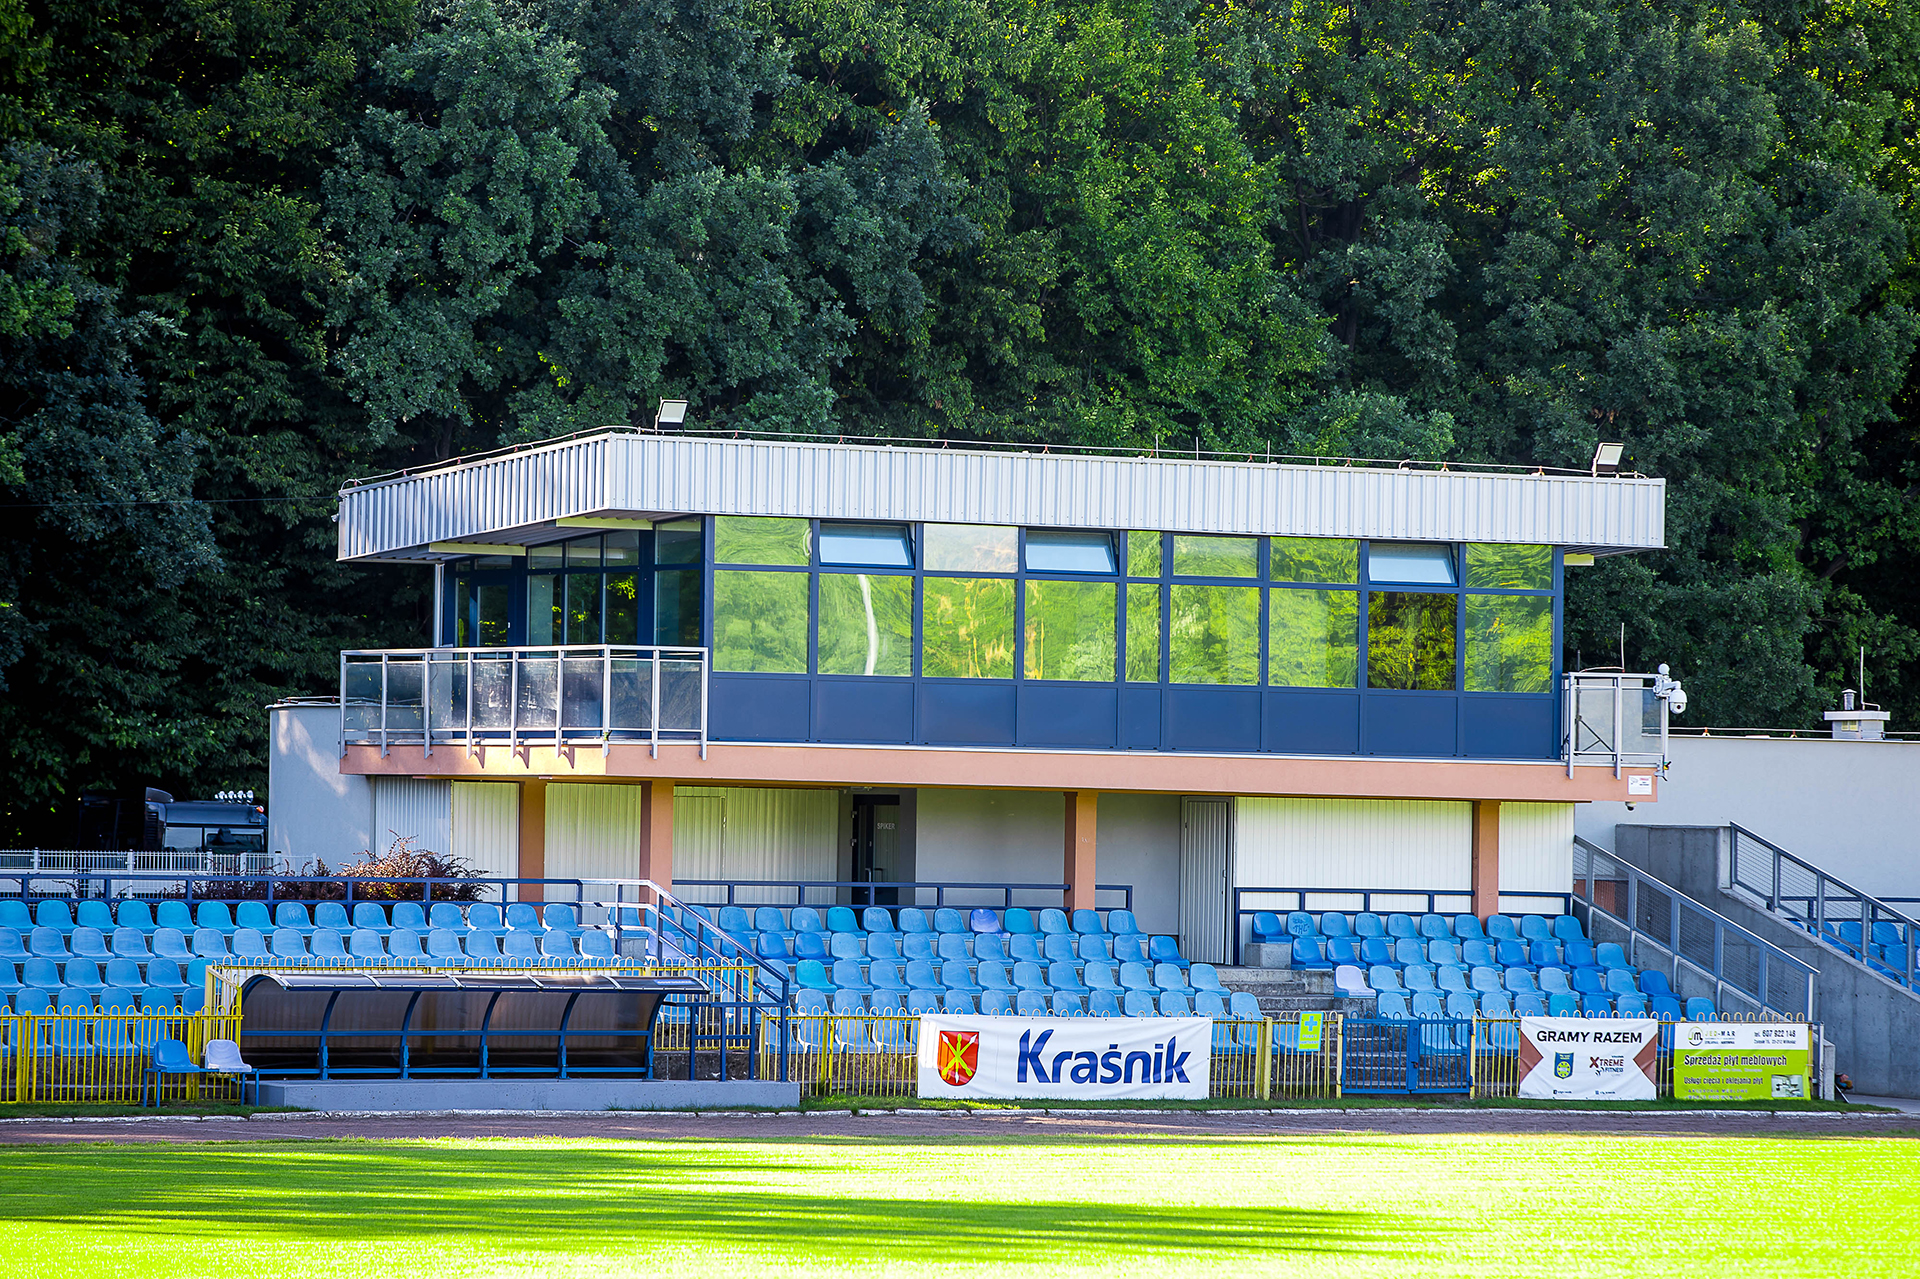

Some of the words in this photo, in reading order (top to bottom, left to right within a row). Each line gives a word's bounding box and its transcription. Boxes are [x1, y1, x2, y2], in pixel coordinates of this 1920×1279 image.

[1537, 1031, 1590, 1043] GRAMY
[1593, 1032, 1642, 1043] RAZEM
[1017, 1028, 1192, 1084] Kraśnik
[1684, 1054, 1721, 1066] Sprzedaż
[1724, 1054, 1739, 1066] płyt
[1741, 1055, 1787, 1067] meblowych
[1589, 1057, 1624, 1068] XTREME
[1684, 1077, 1702, 1085] Usługi
[1703, 1077, 1720, 1085] cięcia
[1752, 1077, 1763, 1085] płyt
